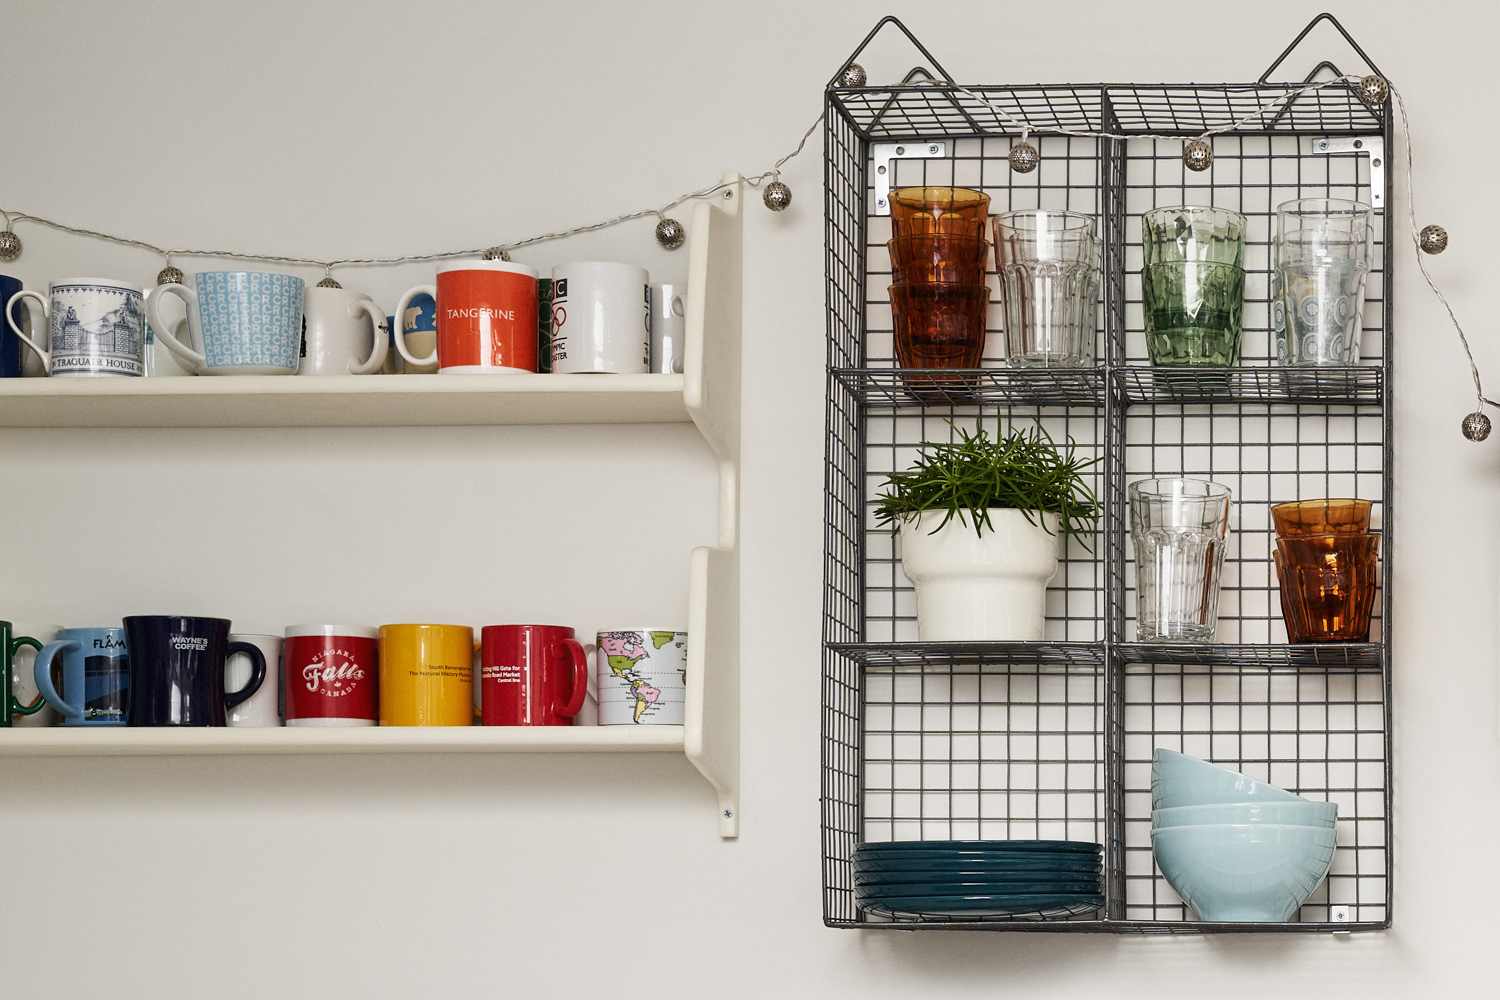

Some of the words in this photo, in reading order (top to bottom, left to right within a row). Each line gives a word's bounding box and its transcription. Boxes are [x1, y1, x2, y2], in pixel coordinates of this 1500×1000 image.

[447, 308, 515, 321] TANGERINE
[57, 357, 103, 367] TRAQUAIR
[106, 360, 136, 371] HOUSE
[172, 636, 208, 645] WAYNE'S
[174, 643, 207, 651] COFFEE
[312, 649, 355, 663] NIAGARA
[302, 661, 366, 693] Falls
[320, 682, 357, 697] CANADA
